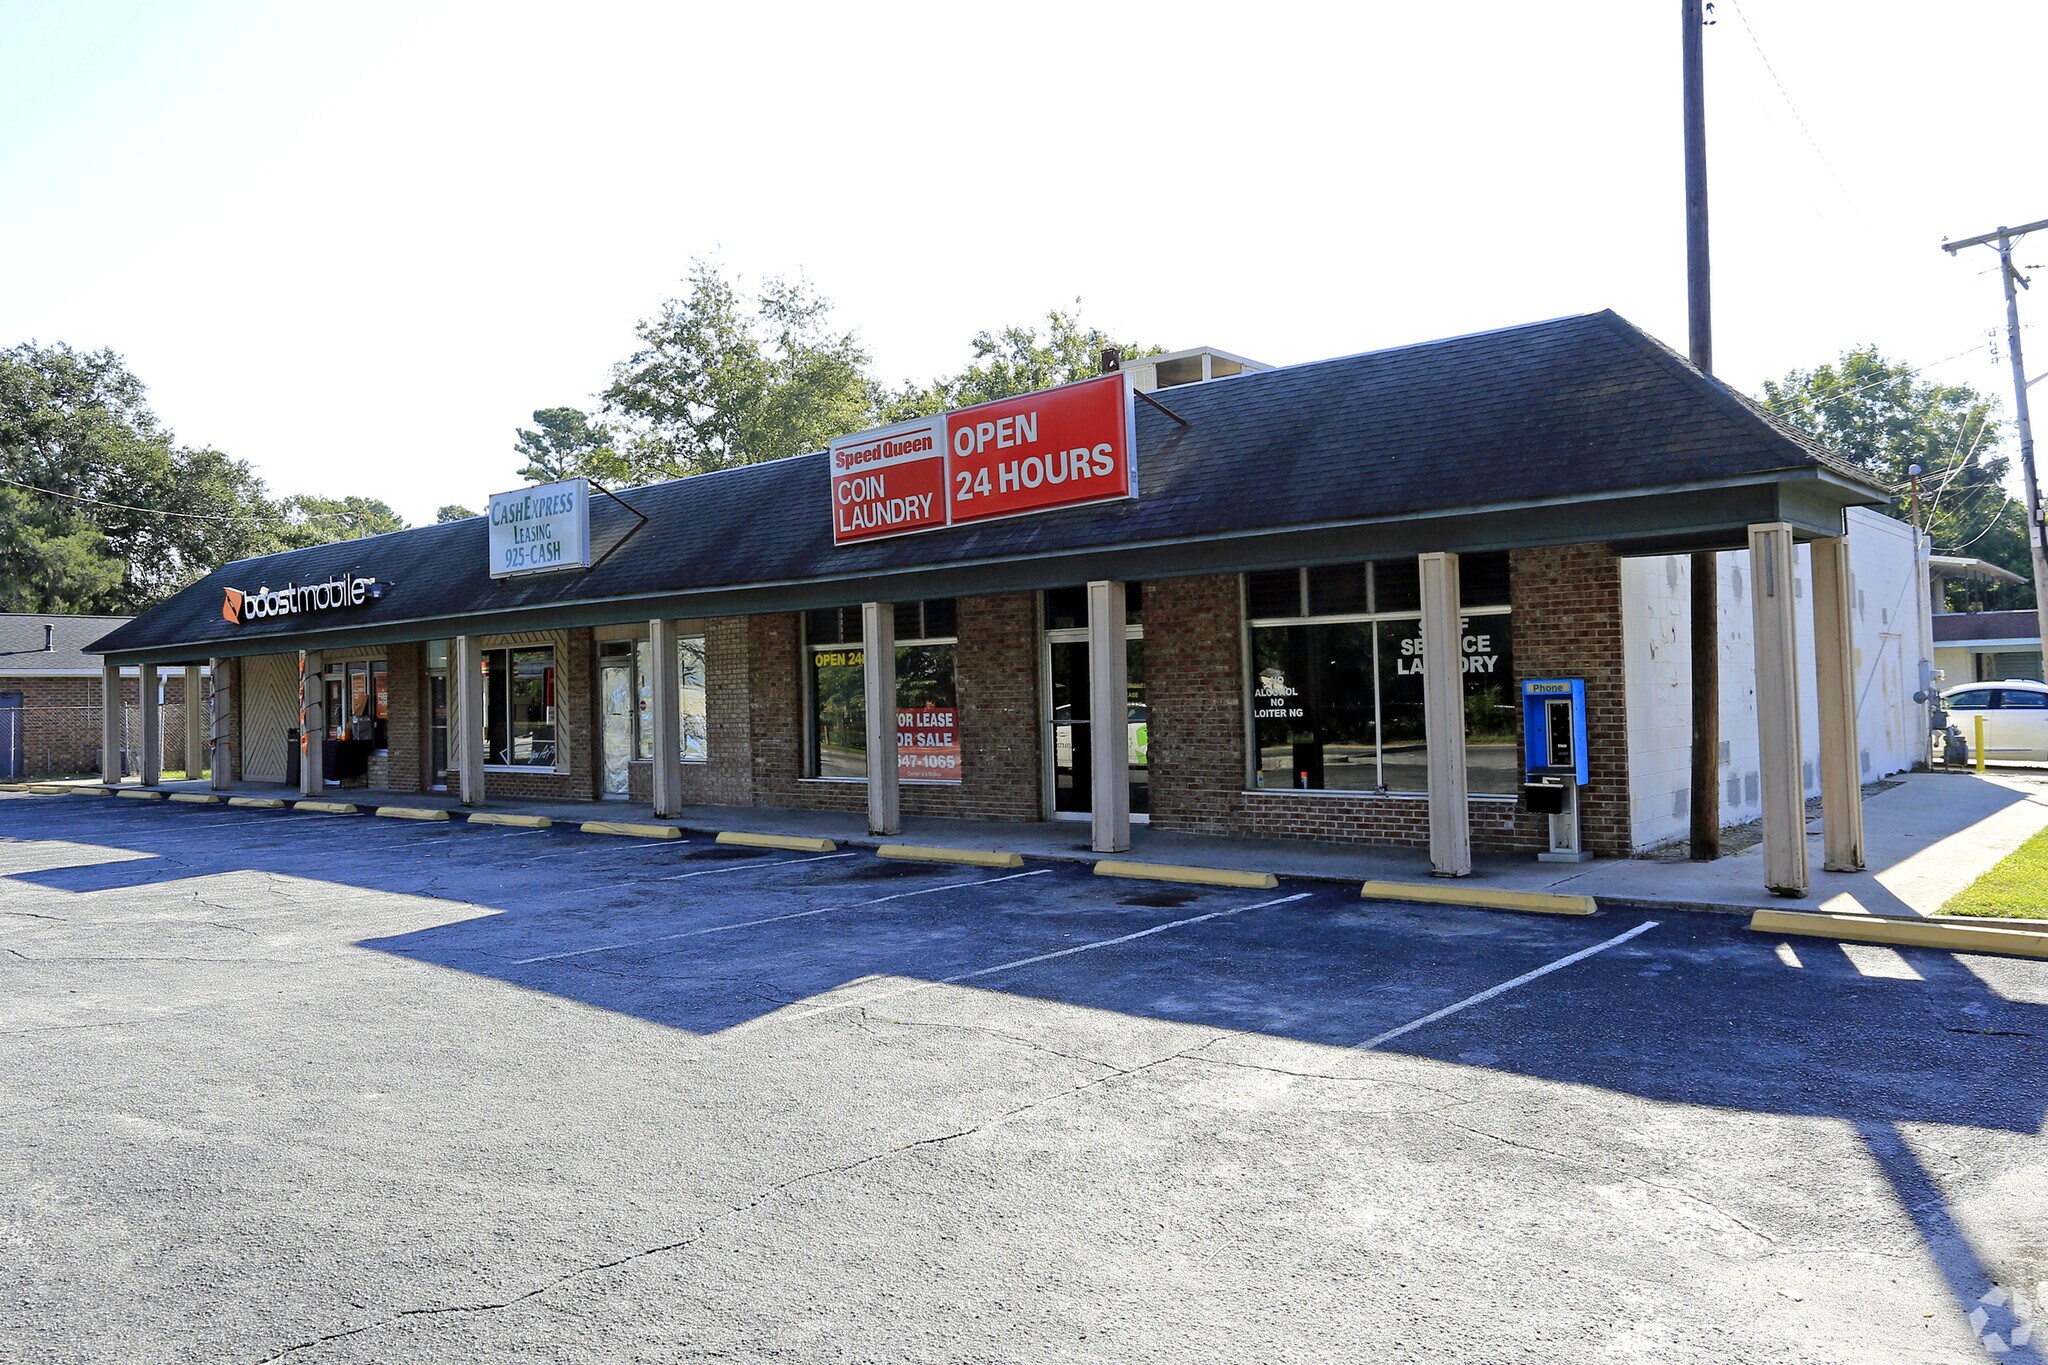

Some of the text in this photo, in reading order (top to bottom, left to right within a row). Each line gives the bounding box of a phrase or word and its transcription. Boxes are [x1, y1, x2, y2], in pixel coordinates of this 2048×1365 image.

[953, 411, 1038, 457] OPEN
[835, 435, 933, 470] Speed Queen
[956, 442, 1115, 501] 24 HOURS
[837, 474, 885, 505] COIN
[839, 492, 933, 532] LAUNDRY
[505, 541, 561, 568] 925-CASH
[1401, 635, 1491, 655] SECE
[815, 653, 846, 667] OPEN
[1397, 655, 1499, 675] LADRY
[1533, 684, 1563, 693] Phone
[1270, 698, 1285, 706] NO
[896, 713, 953, 727] OR LEASE
[917, 732, 953, 747] SALE
